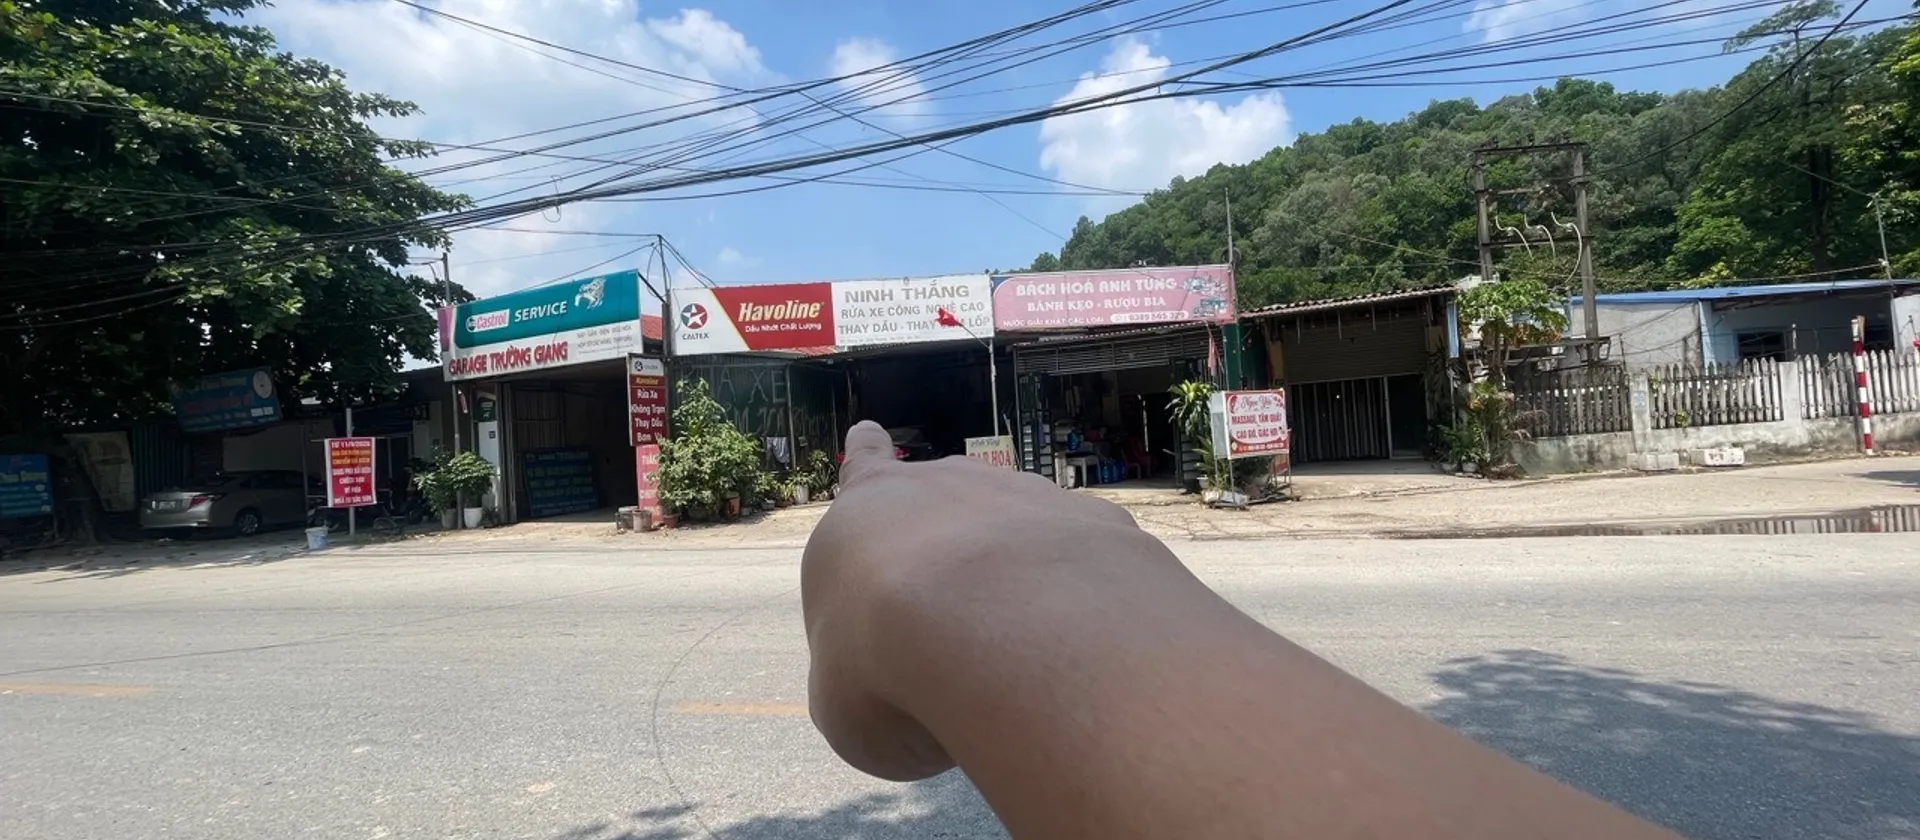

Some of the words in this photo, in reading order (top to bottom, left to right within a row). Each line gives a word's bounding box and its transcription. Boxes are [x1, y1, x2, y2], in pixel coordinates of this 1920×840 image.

[844, 288, 894, 304] NINH
[901, 279, 970, 301] THẮNG
[1016, 280, 1056, 297] BÁCH
[1099, 279, 1131, 293] ANH
[738, 299, 821, 322] Havoline
[841, 302, 866, 319] RỬA
[869, 307, 886, 318] XE
[887, 301, 921, 316] CÔNG
[960, 302, 985, 315] CAO
[1027, 300, 1064, 312] BÁNH
[1067, 301, 1093, 311] KẸO
[1143, 296, 1167, 307] BIA
[475, 311, 507, 330] Castrol
[514, 301, 568, 322] SERVICE
[838, 321, 869, 335] THAY
[872, 319, 898, 333] DẦU
[907, 320, 936, 331] THAY
[682, 332, 709, 341] CALTEX
[449, 353, 487, 376] GARAGE
[489, 345, 531, 372] TRƯỜNG
[535, 340, 569, 369] GIANG
[634, 417, 650, 429] Thay
